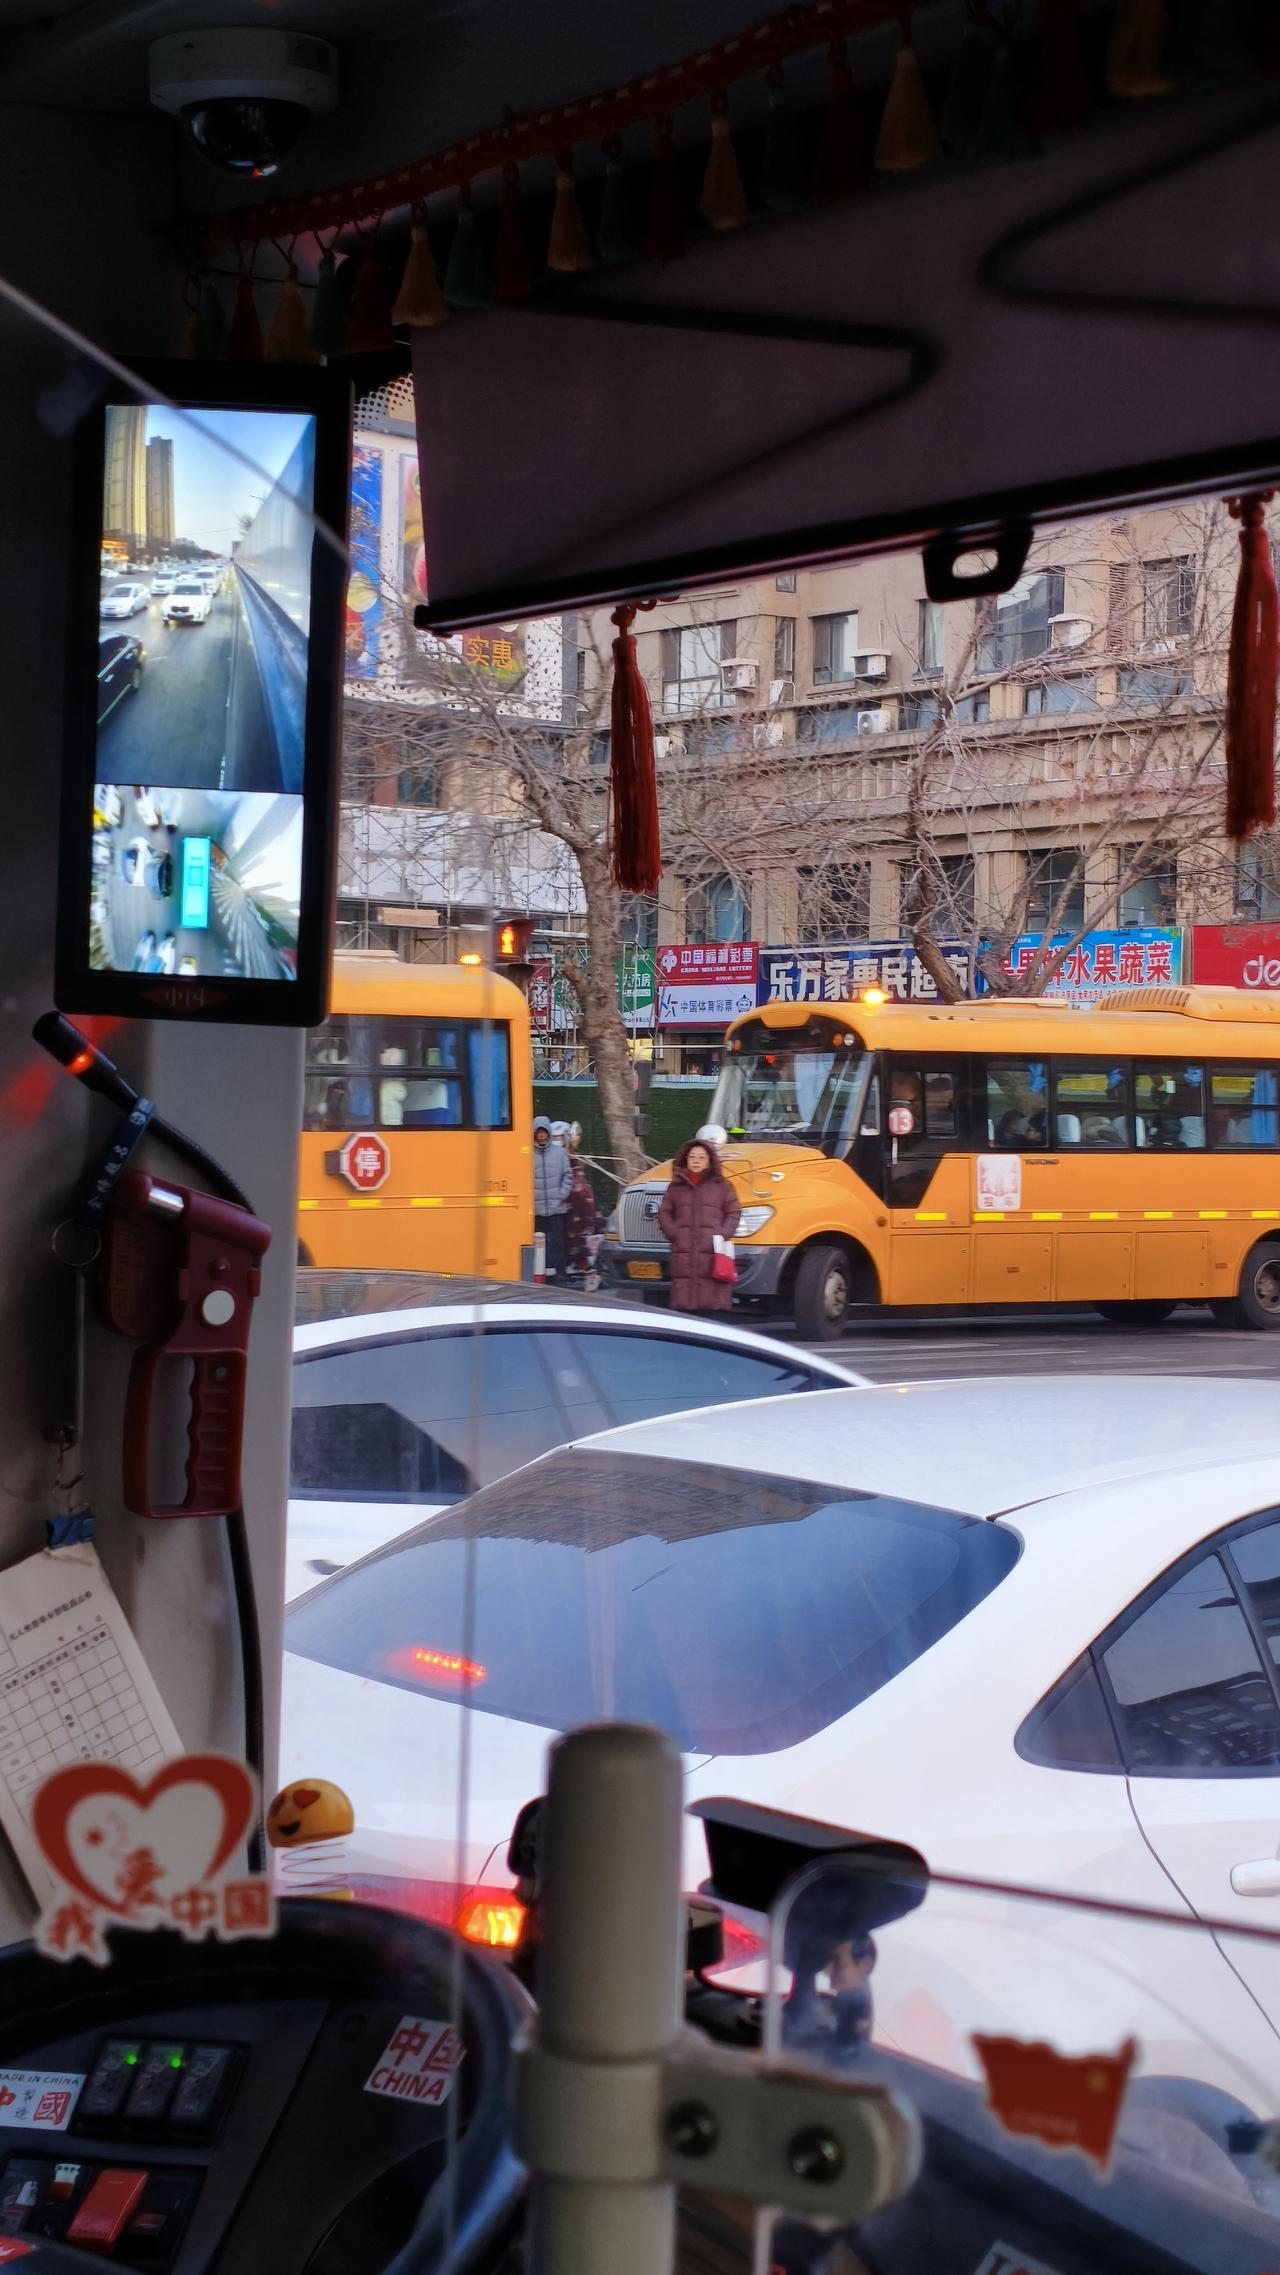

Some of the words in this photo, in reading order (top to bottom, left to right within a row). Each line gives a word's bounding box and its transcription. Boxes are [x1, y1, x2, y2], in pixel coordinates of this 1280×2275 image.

[467, 635, 512, 669] 实惠
[681, 947, 753, 965] 中国福利彩票
[681, 999, 733, 1013] 中国体育彩票
[888, 1110, 912, 1131] 13
[354, 1147, 381, 1178] 停
[27, 2075, 41, 2083] IN
[44, 2076, 80, 2086] CHINA
[371, 2067, 446, 2102] CHINA
